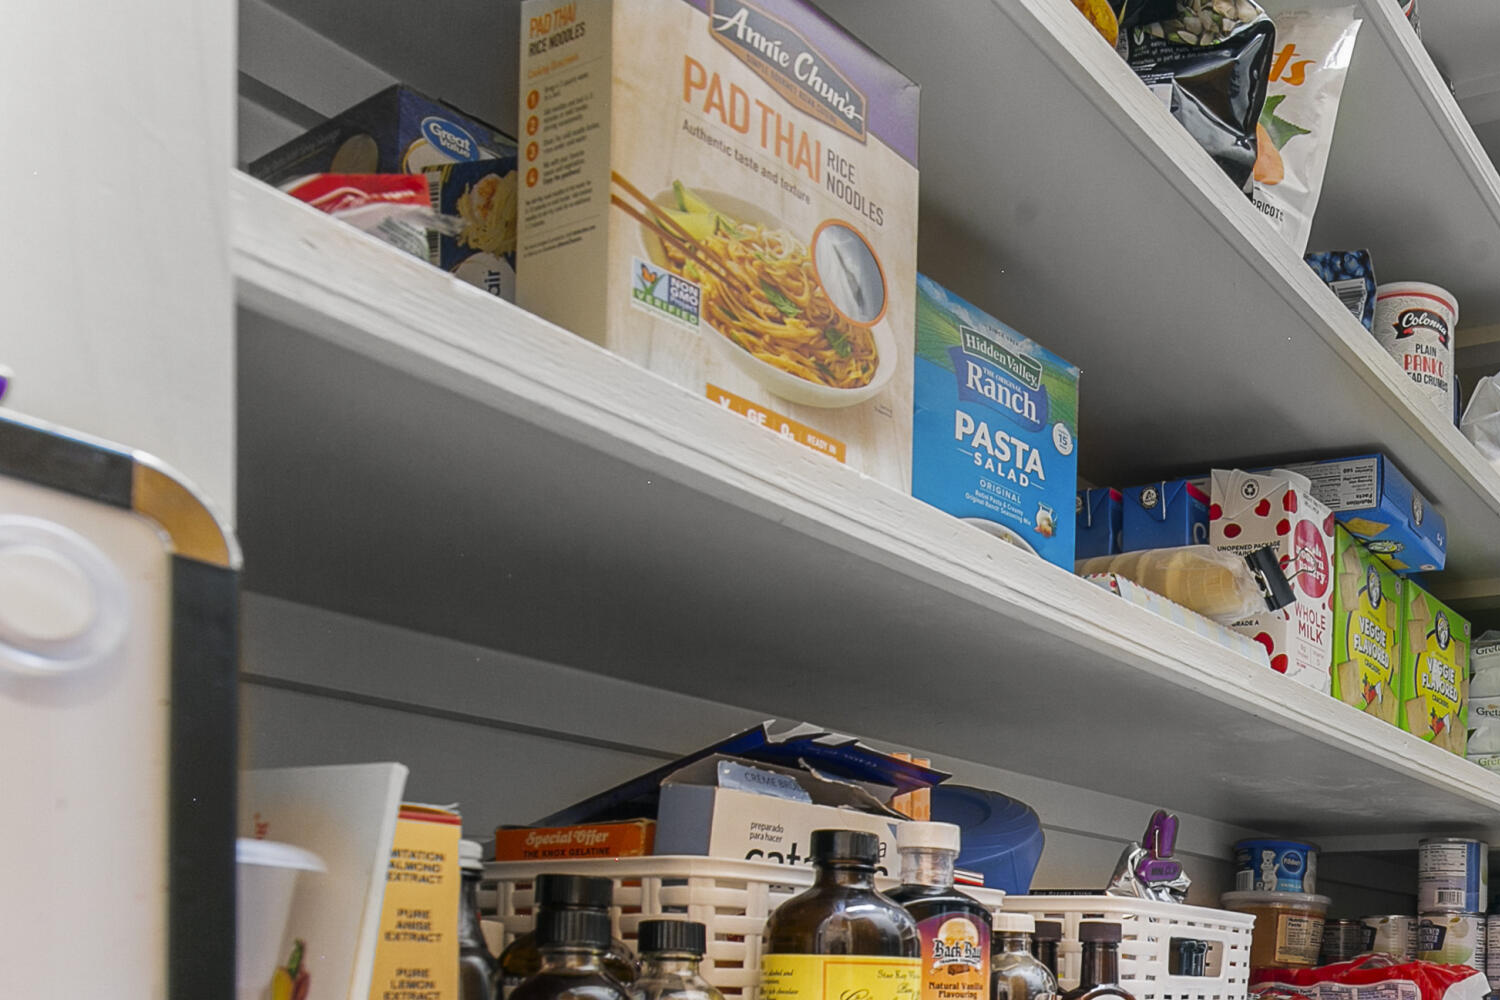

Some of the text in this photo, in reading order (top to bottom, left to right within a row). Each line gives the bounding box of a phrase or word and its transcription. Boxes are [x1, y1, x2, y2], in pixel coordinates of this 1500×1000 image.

[713, 8, 790, 66] Annie
[794, 52, 864, 121] Chun's
[430, 122, 470, 149] Great
[683, 54, 750, 134] PAD
[755, 99, 821, 184] THAI
[682, 119, 731, 156] Authentic
[735, 149, 759, 172] taste
[761, 166, 778, 185] and
[827, 149, 855, 185] RICE
[826, 172, 884, 227] NOODLES
[965, 333, 1038, 388] Hidden Valley
[1416, 343, 1437, 358] PLAIN
[966, 360, 1039, 424] Ranch
[954, 409, 1045, 481] PASTA
[974, 451, 1029, 487] SALAD
[979, 479, 1022, 504] ORIGINAL
[1298, 620, 1323, 646] MILK
[1358, 615, 1387, 649] VEGGIE
[1353, 633, 1389, 669] FLAVORED
[749, 831, 763, 842] para
[750, 820, 784, 835] preparado
